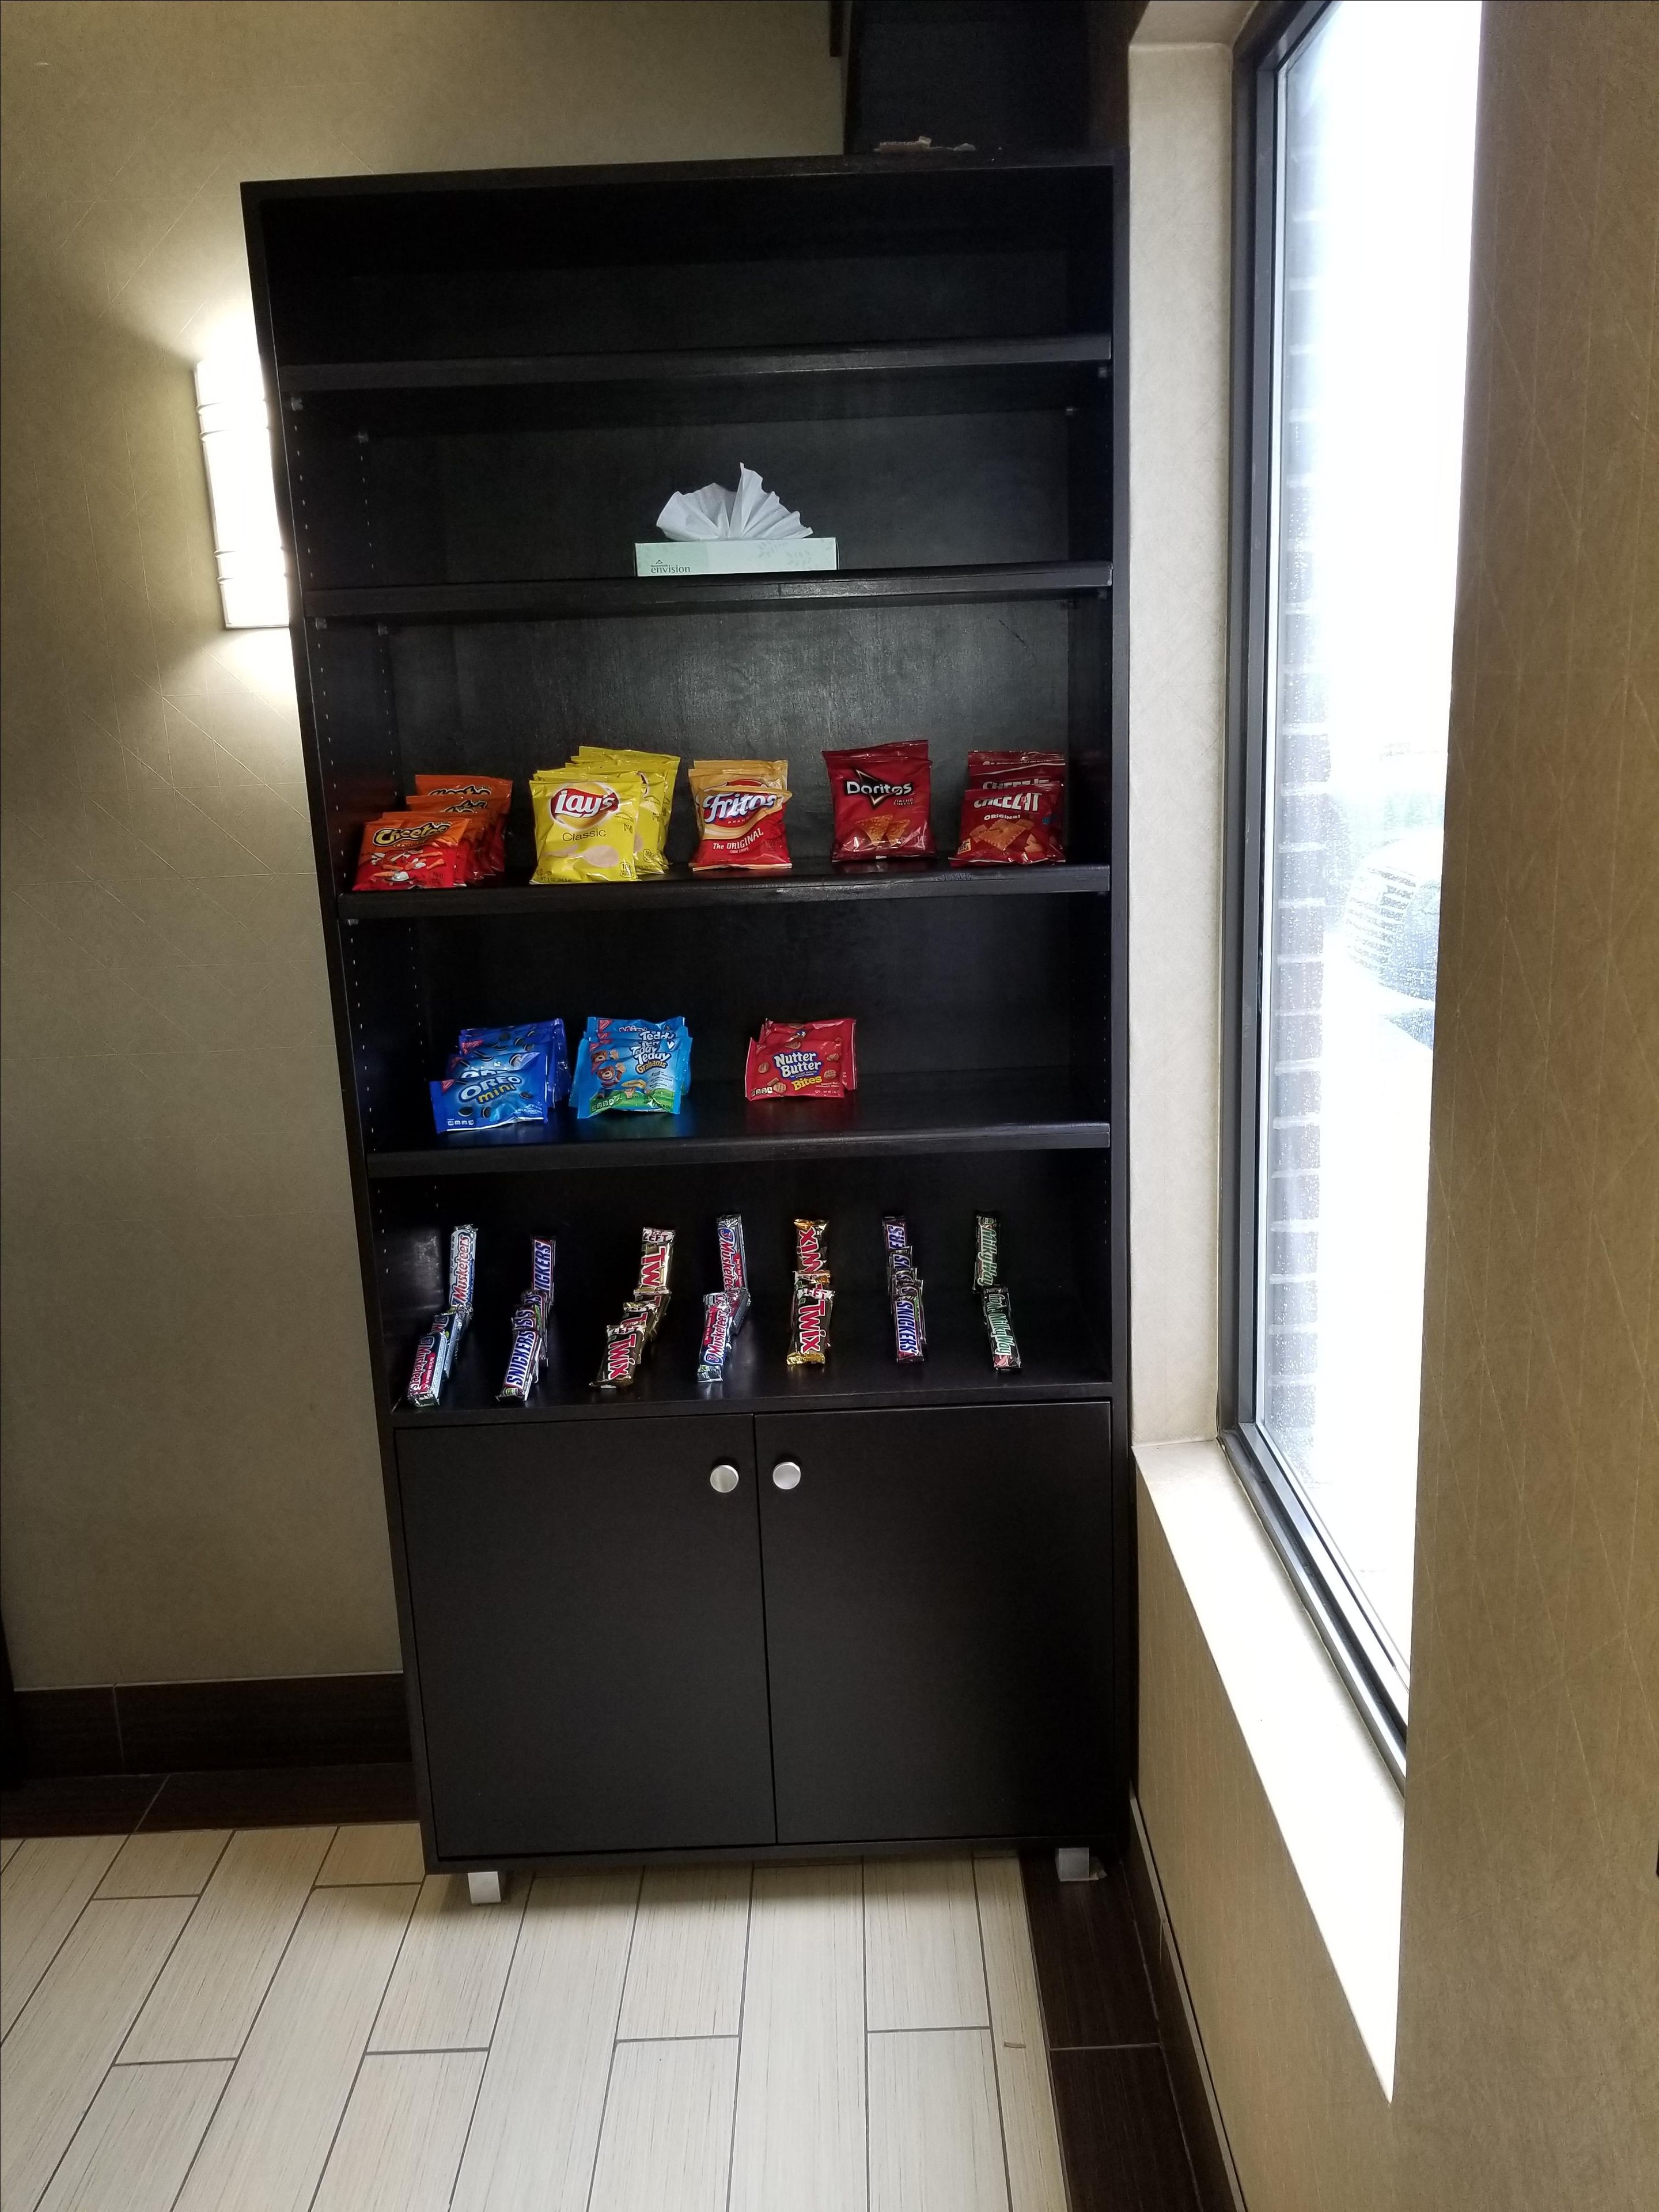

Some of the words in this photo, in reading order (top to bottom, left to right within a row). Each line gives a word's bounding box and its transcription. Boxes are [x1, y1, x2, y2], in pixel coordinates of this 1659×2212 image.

[651, 565, 691, 574] envision
[846, 781, 912, 796] Doritos
[555, 788, 615, 819] Lay's
[702, 792, 777, 823] Fritos
[374, 822, 451, 846] Cheetos
[562, 828, 607, 842] Classic
[726, 827, 764, 850] ORIGINAL
[636, 1060, 667, 1074] Grahams
[774, 1052, 817, 1065] Nutter
[781, 1060, 822, 1078] Butter
[461, 1076, 521, 1100] OREO
[478, 1084, 515, 1103] mini
[791, 1075, 823, 1091] Bites
[452, 1234, 471, 1304] Musketeers
[533, 1240, 552, 1291] ICKERS
[896, 1301, 918, 1352] SNICKERS
[506, 1330, 535, 1387] SNICKERS
